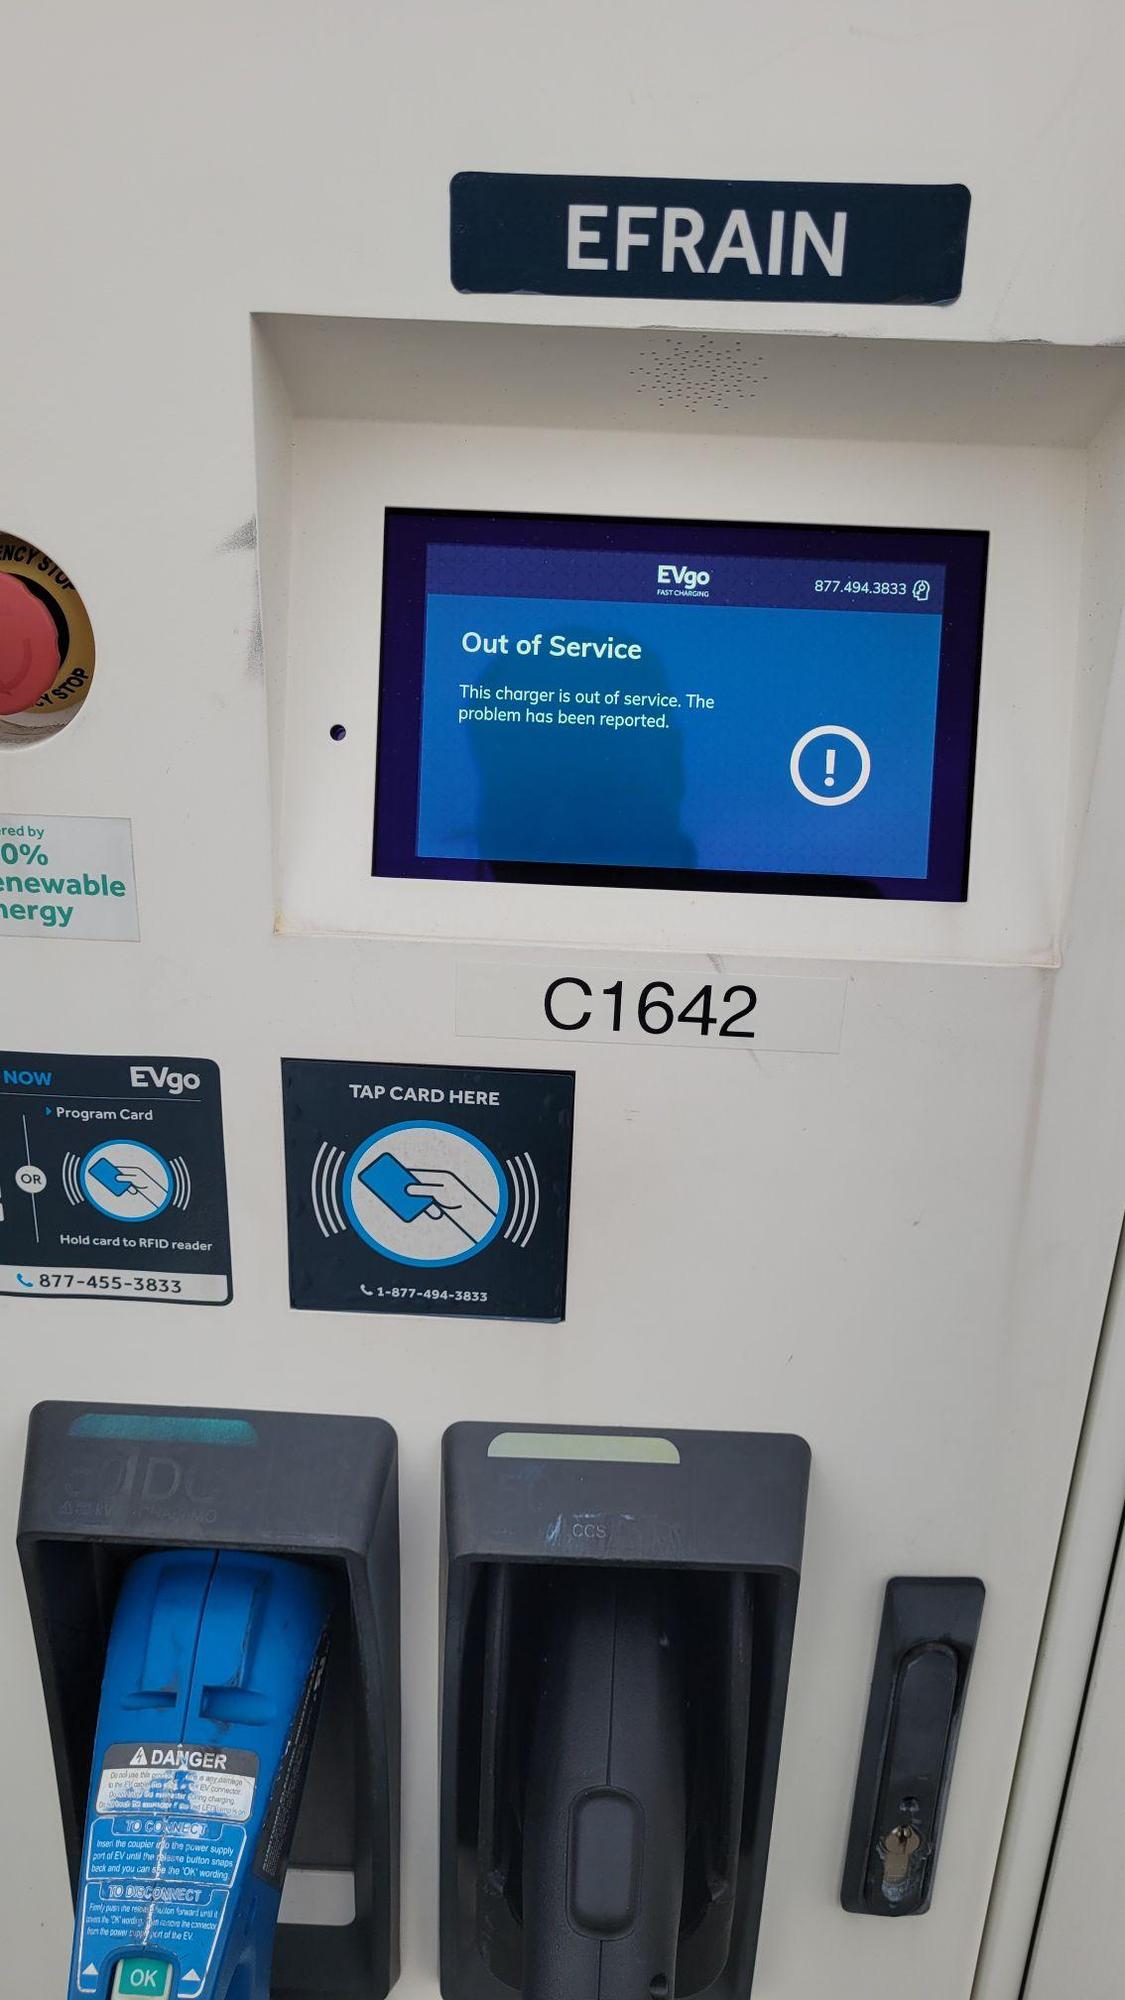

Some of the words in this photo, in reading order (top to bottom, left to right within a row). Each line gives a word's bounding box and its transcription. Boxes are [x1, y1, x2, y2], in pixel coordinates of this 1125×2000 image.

[566, 204, 847, 277] EFRAIN
[0, 544, 40, 564] NCY
[657, 564, 710, 590] EVgo
[656, 588, 673, 596] FAST
[673, 589, 710, 598] CHARGING
[814, 580, 907, 595] 877.494.3833
[462, 631, 508, 654] Out
[516, 633, 543, 656] of
[549, 635, 642, 660] Service
[52, 667, 88, 699] STOP
[459, 684, 491, 700] This
[495, 686, 554, 705] charger
[559, 689, 571, 704] is
[575, 690, 601, 705] out
[604, 690, 620, 705] of
[623, 692, 681, 708] service.
[685, 693, 715, 709] The
[458, 706, 521, 723] problem
[526, 708, 553, 723] has
[557, 709, 595, 725] been
[600, 713, 669, 730] reported.
[0, 826, 24, 837] red
[27, 826, 45, 840] by
[543, 976, 759, 1039] C1642
[3, 1070, 52, 1087] NOW
[130, 1066, 201, 1095] EVgo
[349, 1084, 386, 1099] TAP
[389, 1086, 445, 1103] CARD
[449, 1090, 500, 1106] HERE
[56, 1107, 117, 1122] Program
[119, 1108, 153, 1121] Card
[20, 1173, 42, 1185] OR
[60, 1234, 90, 1245] Hold
[93, 1236, 120, 1247] card
[122, 1237, 137, 1247] to
[139, 1238, 169, 1249] RFID
[172, 1240, 213, 1251] reader
[39, 1274, 182, 1293] 877-455-3833
[376, 1286, 488, 1302] 1-877-494-3833
[572, 1523, 607, 1538] CCS
[151, 1749, 227, 1770] DANGER
[125, 1820, 142, 1833] TO
[115, 1840, 126, 1848] the
[127, 1840, 154, 1849] coupler
[185, 1844, 209, 1852] power
[210, 1846, 234, 1857] supply
[114, 1851, 126, 1860] EV
[126, 1852, 142, 1860] until
[186, 1856, 209, 1864] button
[211, 1858, 233, 1868] snaps
[108, 1864, 121, 1873] and
[121, 1866, 135, 1875] you
[108, 1885, 124, 1898] TO
[130, 1968, 158, 1988] OK
